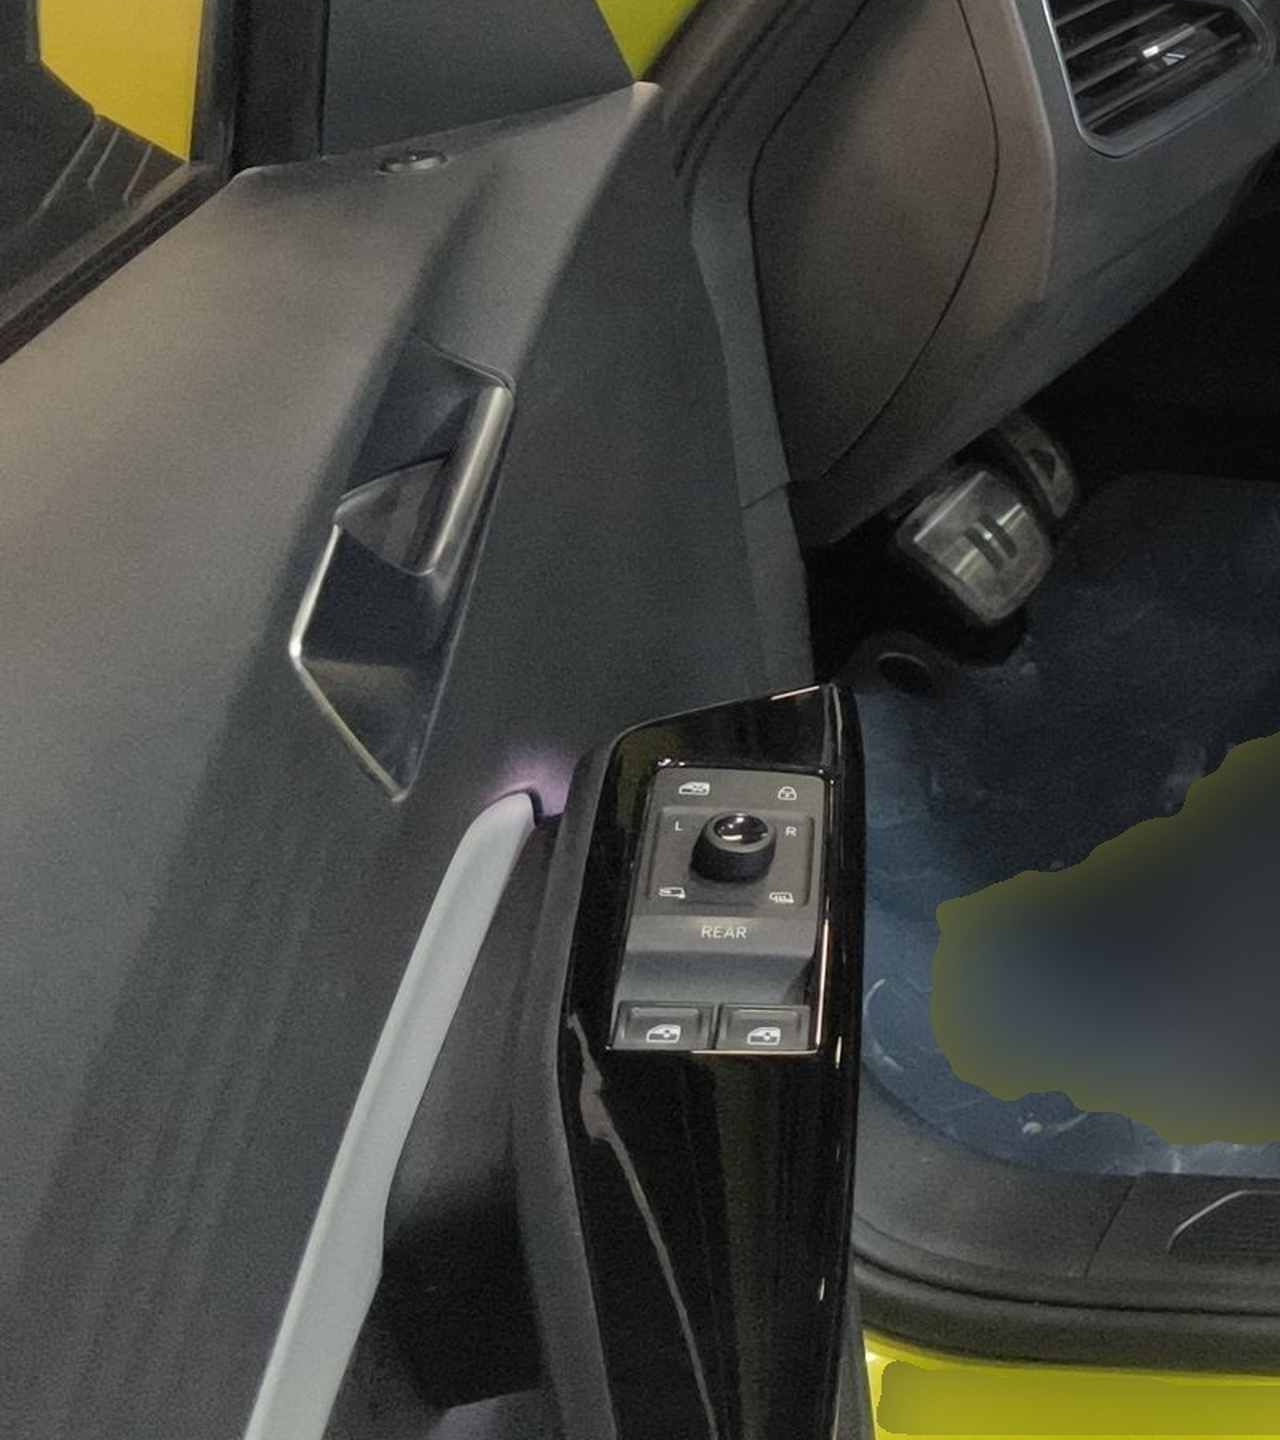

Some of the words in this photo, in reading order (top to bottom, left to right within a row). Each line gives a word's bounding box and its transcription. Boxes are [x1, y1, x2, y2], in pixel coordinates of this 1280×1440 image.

[674, 820, 683, 832] L
[785, 826, 797, 837] R
[700, 925, 748, 940] REAR
